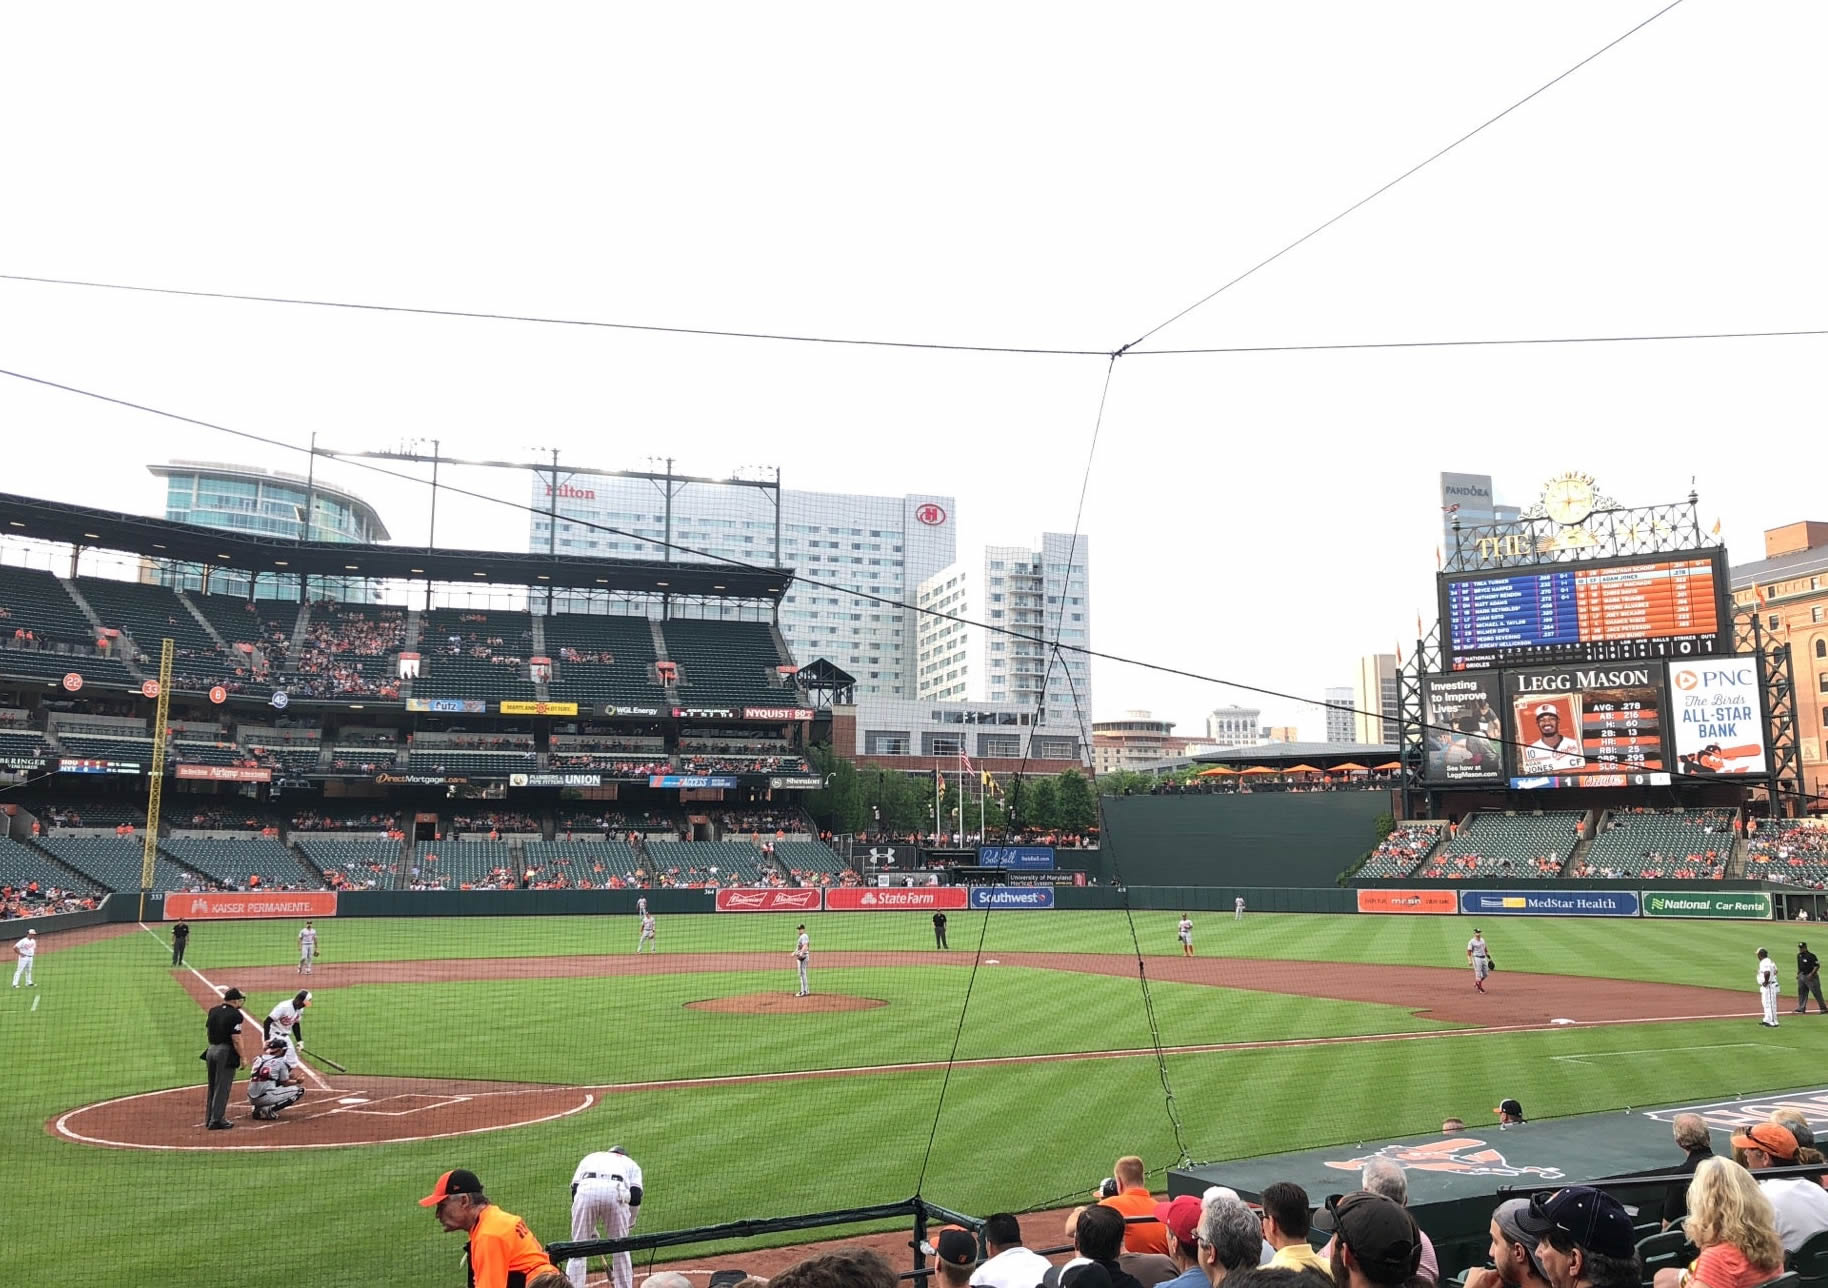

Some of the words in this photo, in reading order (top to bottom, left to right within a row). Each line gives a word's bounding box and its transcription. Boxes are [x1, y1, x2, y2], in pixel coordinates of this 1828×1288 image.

[1658, 644, 1664, 655] 1
[1680, 642, 1691, 654] 0
[1706, 640, 1712, 652] 1
[66, 678, 80, 686] 22
[1518, 675, 1570, 692] LEGG
[1576, 670, 1648, 688] MASON
[1702, 669, 1752, 687] PNC
[145, 684, 158, 694] 33
[1431, 681, 1477, 691] Investing
[216, 690, 220, 700] 8
[274, 696, 286, 704] 42
[1445, 692, 1486, 702] Improve
[1686, 696, 1708, 706] The
[1712, 694, 1746, 706] Birds
[442, 702, 456, 710] utz
[633, 707, 658, 715] Energy
[1594, 704, 1614, 712] AVG:
[1621, 702, 1640, 710] .278
[1683, 706, 1752, 722] ALL-STAR
[1699, 723, 1737, 738] BANK
[1527, 750, 1536, 758] 10
[1527, 764, 1554, 773] JONES
[565, 774, 600, 784] UNION
[1565, 778, 1572, 786] 1
[1636, 775, 1644, 784] 0
[1010, 874, 1040, 882] University
[1046, 874, 1072, 882] Maryland
[980, 892, 1038, 902] Southwest
[212, 903, 244, 912] KAISER
[1528, 899, 1574, 909] MedStar
[1577, 899, 1616, 909] Health
[1664, 900, 1710, 910] National
[1716, 902, 1734, 910] Car
[1735, 902, 1764, 910] Rental
